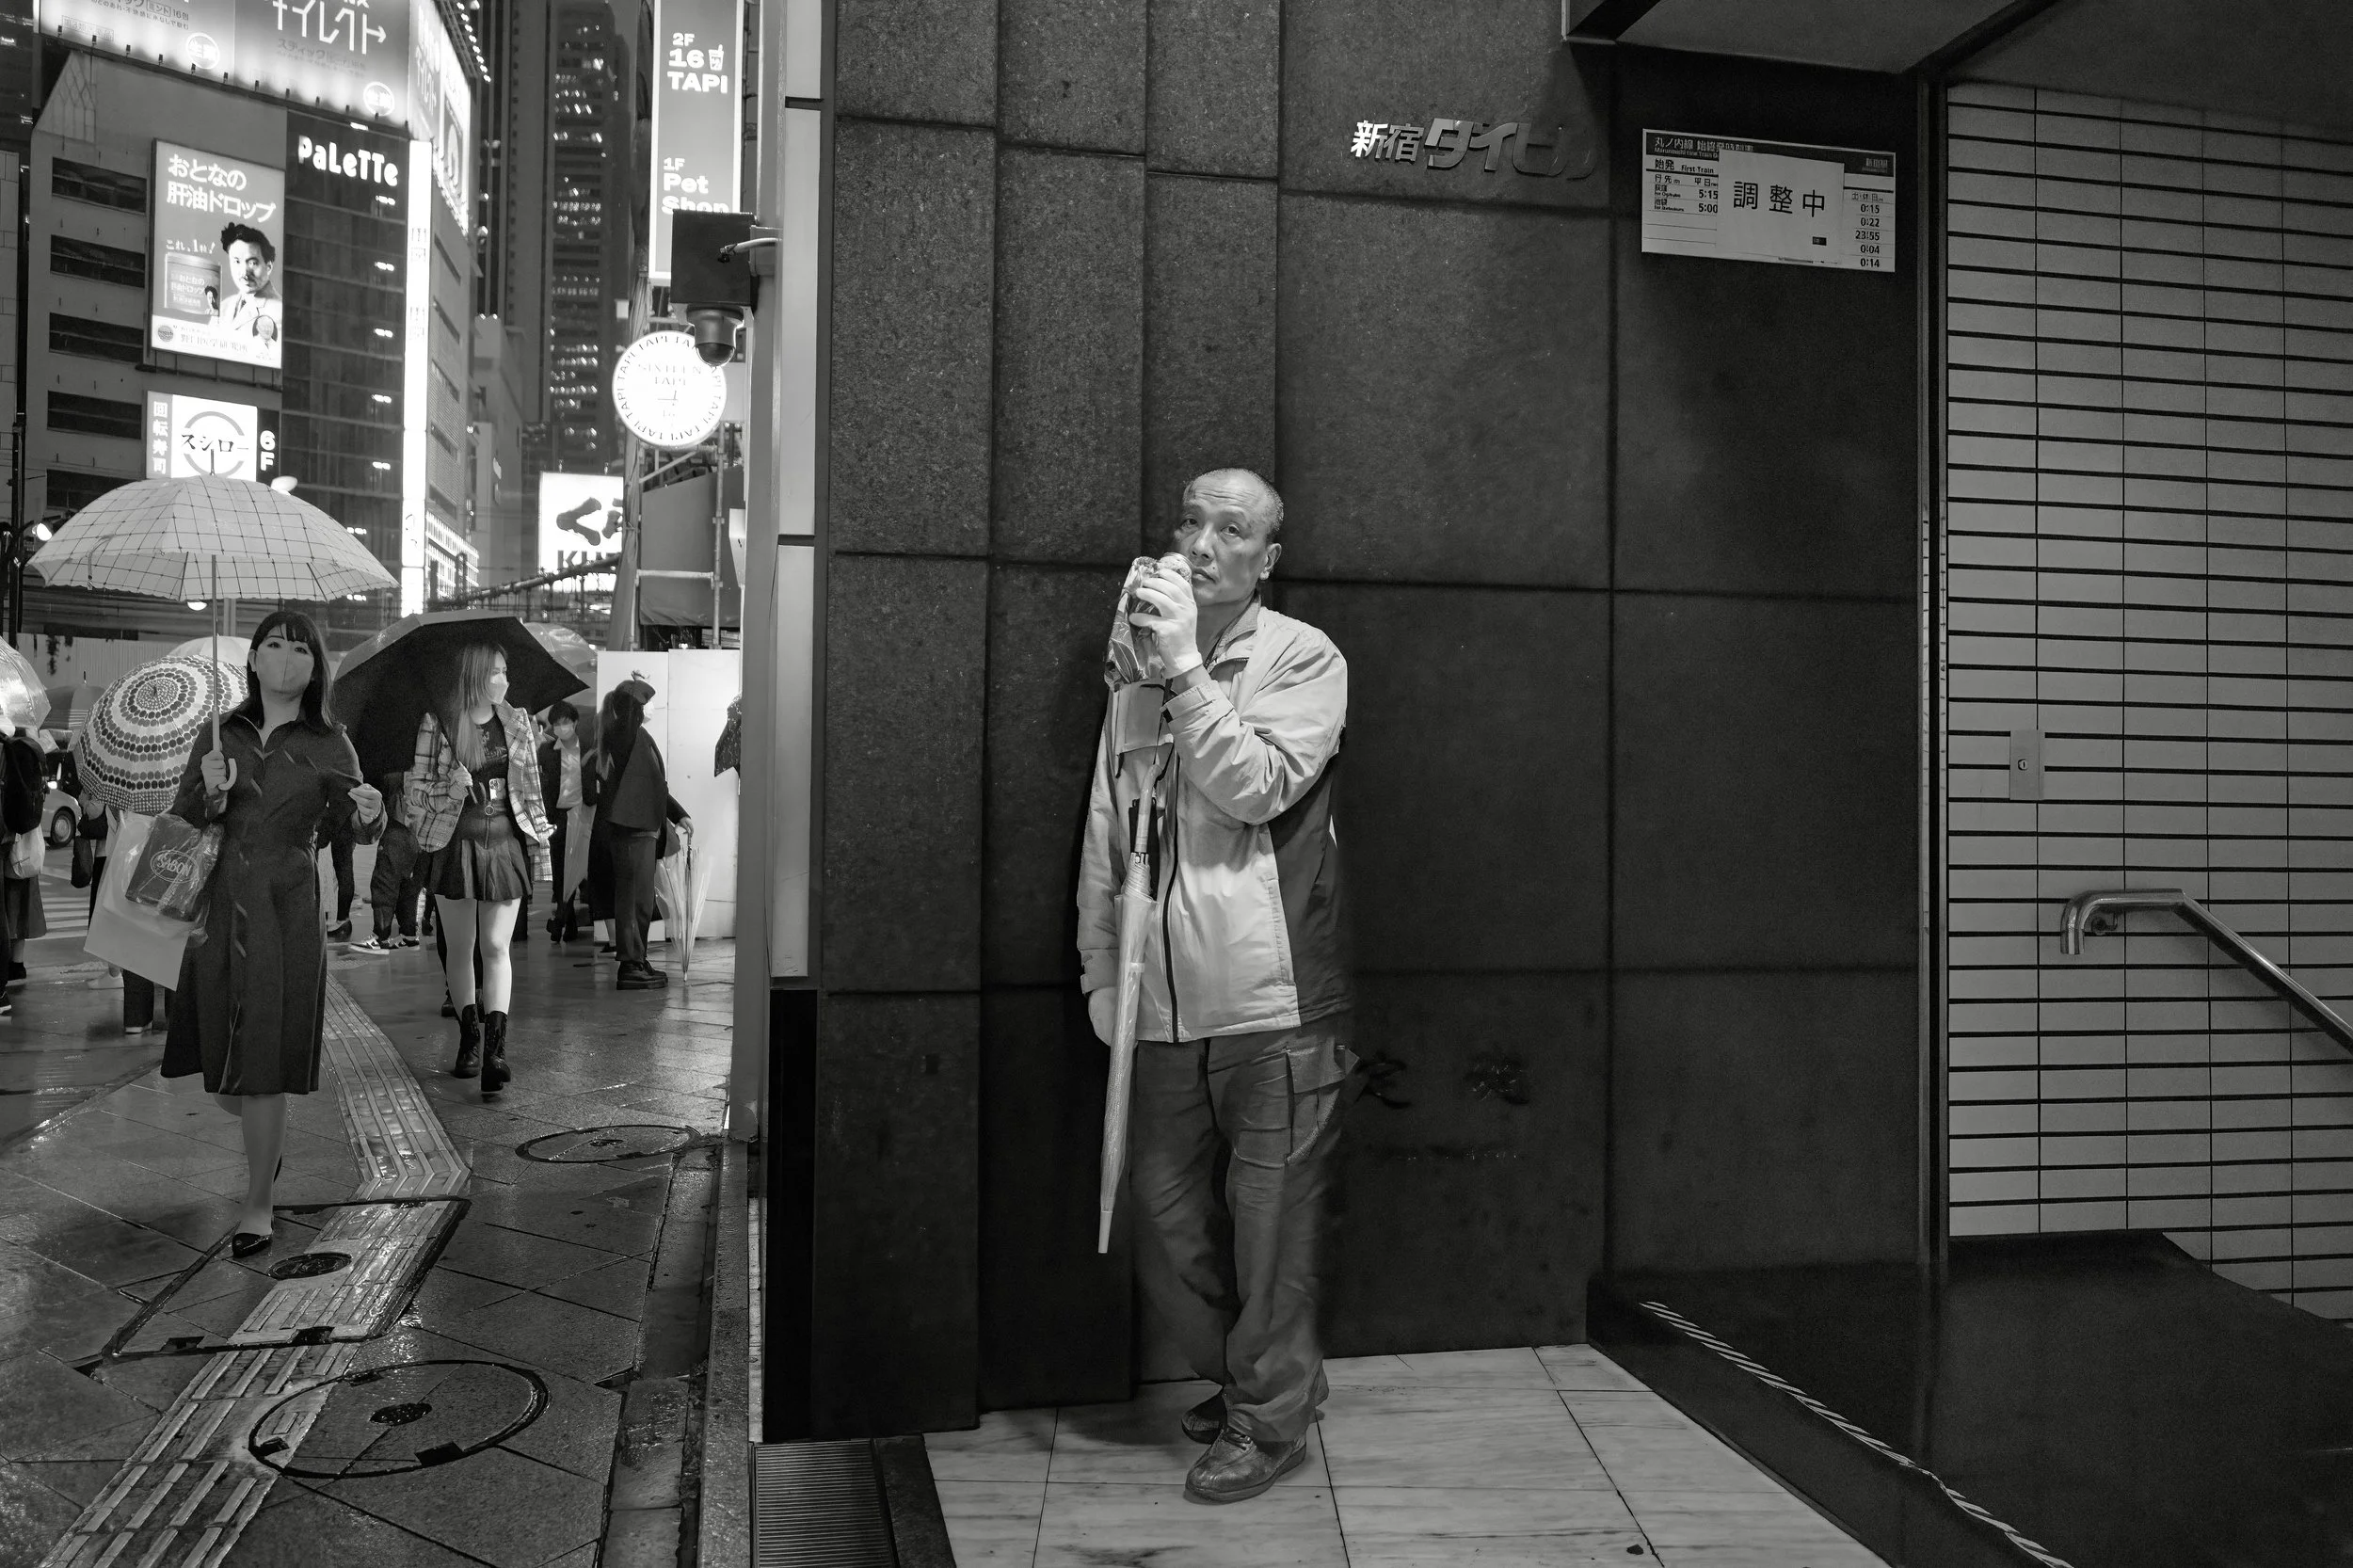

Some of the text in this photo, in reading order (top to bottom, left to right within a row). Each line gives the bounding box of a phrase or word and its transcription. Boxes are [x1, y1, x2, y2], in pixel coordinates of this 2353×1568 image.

[673, 33, 695, 46] 2F
[668, 48, 705, 69] 16
[666, 71, 728, 94] TAPI
[168, 153, 247, 191] おとなの
[664, 157, 686, 171] 1F
[1655, 158, 1674, 170] 始発
[664, 172, 709, 194] Pet
[167, 180, 277, 222] 肝油ドロップ
[1698, 189, 1719, 200] 5:15
[1733, 180, 1826, 218] 調整中
[1698, 202, 1719, 214] 5:00
[1860, 203, 1881, 214] 0:15
[1860, 216, 1881, 228] 0:22
[1855, 230, 1881, 241] 23:55
[1860, 244, 1881, 255] 0:04
[1860, 257, 1881, 268] 0:14
[617, 351, 636, 380] TAPI
[616, 388, 633, 420] TAPI
[181, 433, 249, 453] スシロー
[259, 429, 277, 472] 6F
[156, 852, 192, 877] SABON
